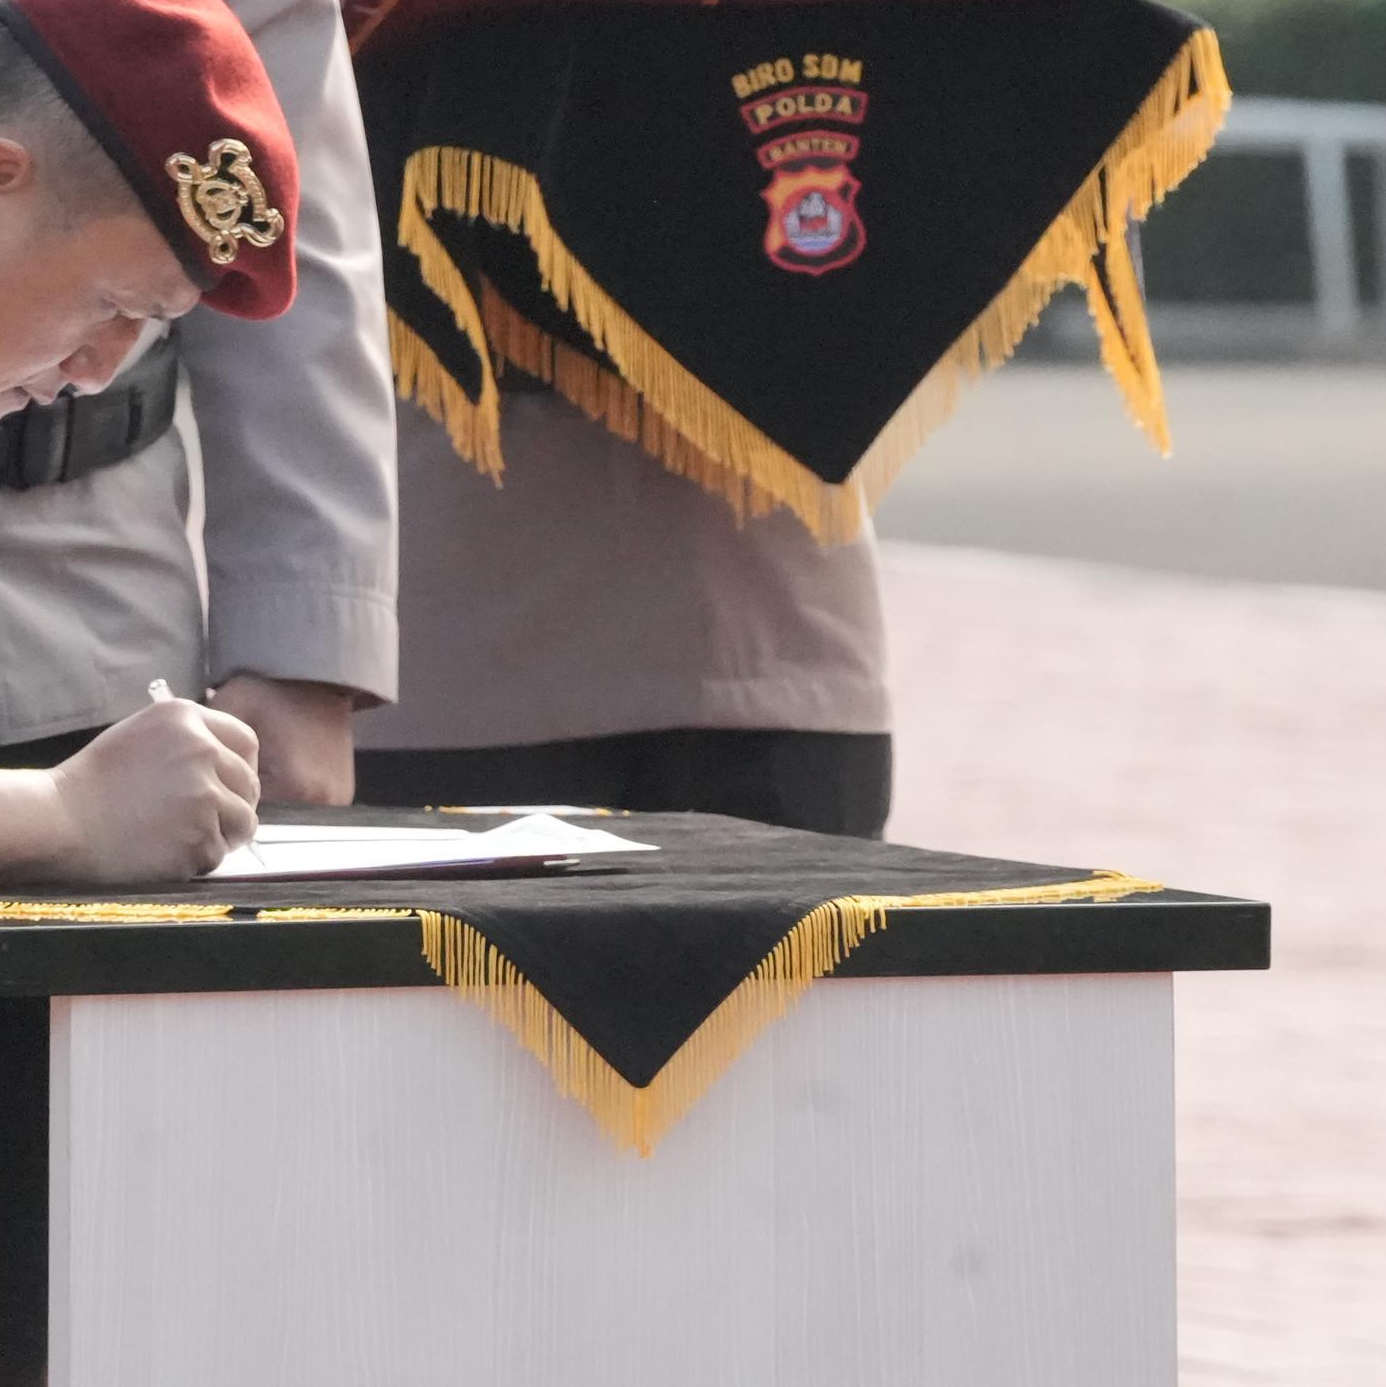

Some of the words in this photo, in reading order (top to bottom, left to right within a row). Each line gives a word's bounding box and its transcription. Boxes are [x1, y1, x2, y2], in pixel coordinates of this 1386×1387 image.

[731, 57, 795, 99] BIRO
[802, 53, 862, 84] SDM
[753, 92, 854, 126] POLDA
[768, 137, 849, 160] BANTEN
